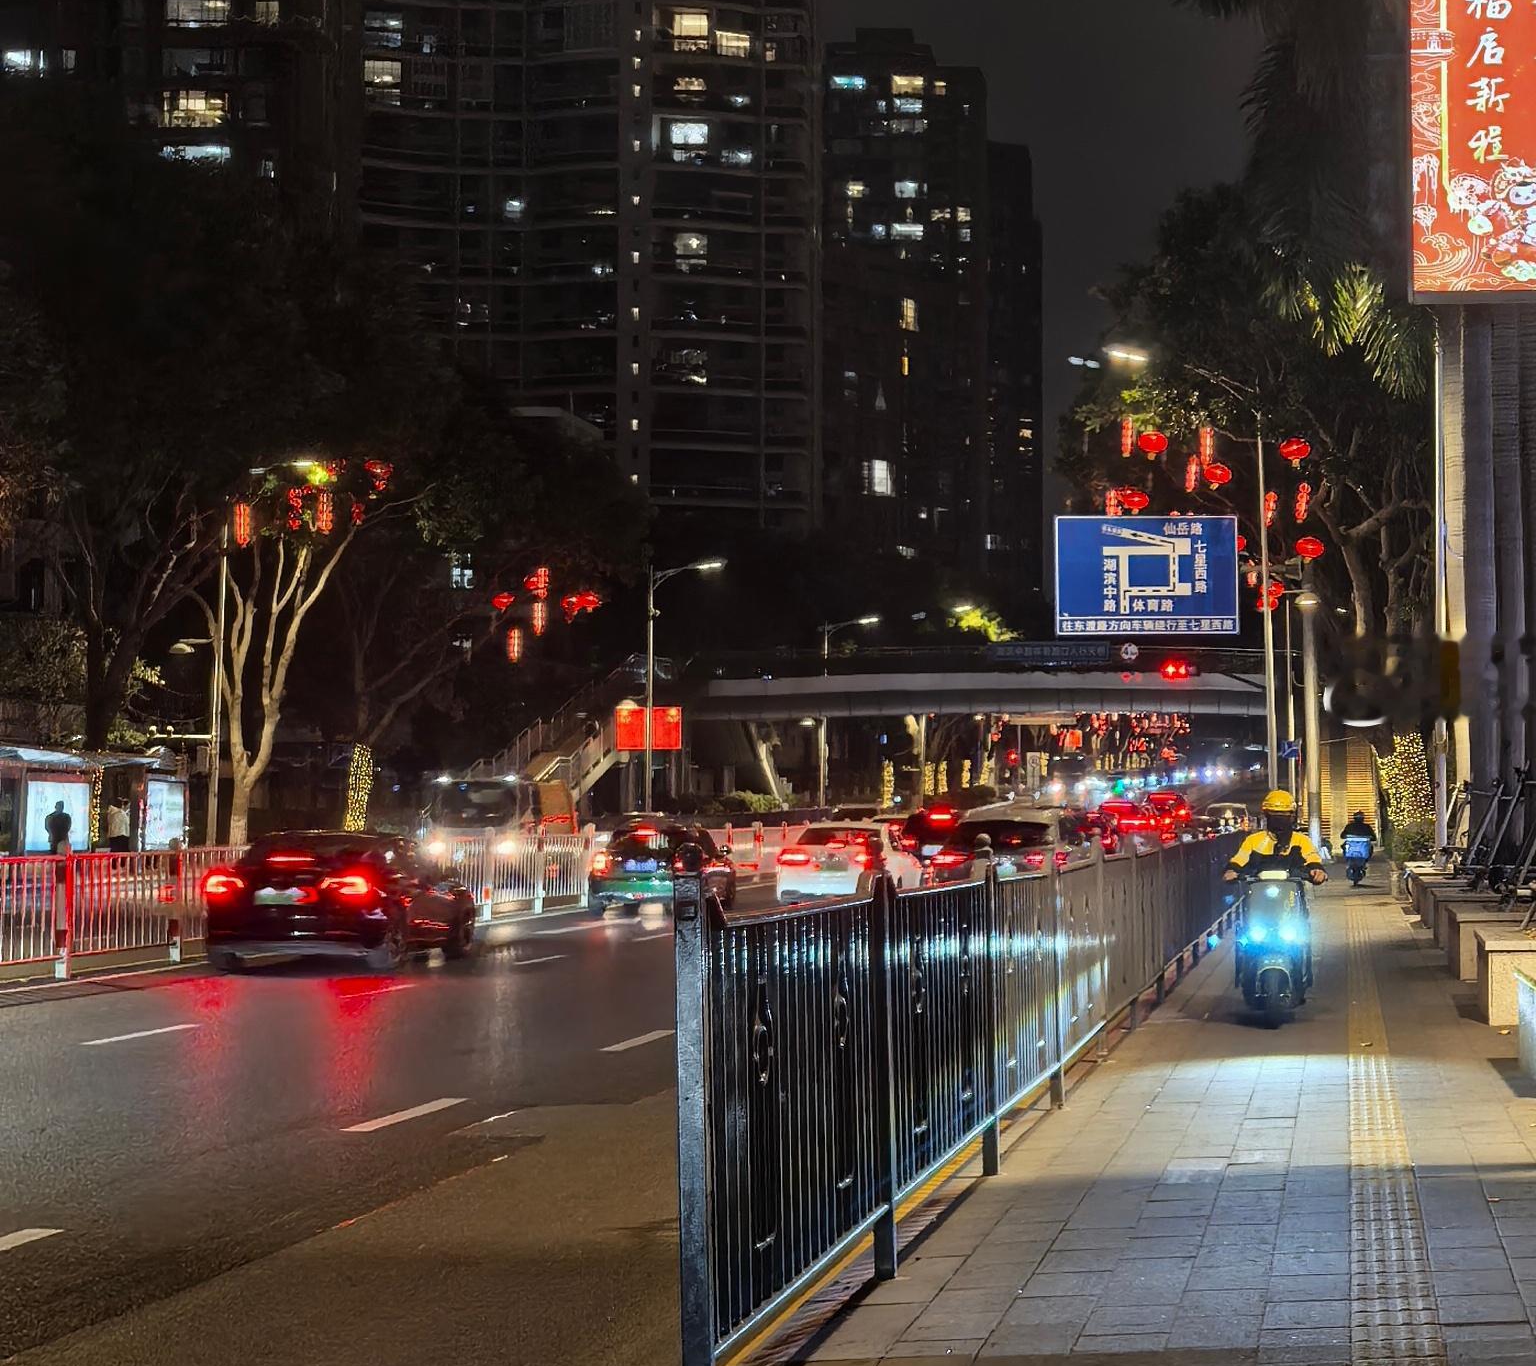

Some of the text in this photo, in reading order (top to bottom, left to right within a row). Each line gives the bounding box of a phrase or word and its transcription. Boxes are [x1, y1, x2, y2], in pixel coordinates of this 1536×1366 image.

[1163, 522, 1203, 535] 仙岳路
[1194, 540, 1208, 593] 七星西路
[1103, 558, 1117, 612] 湖滨中路
[1132, 599, 1175, 612] 体育路
